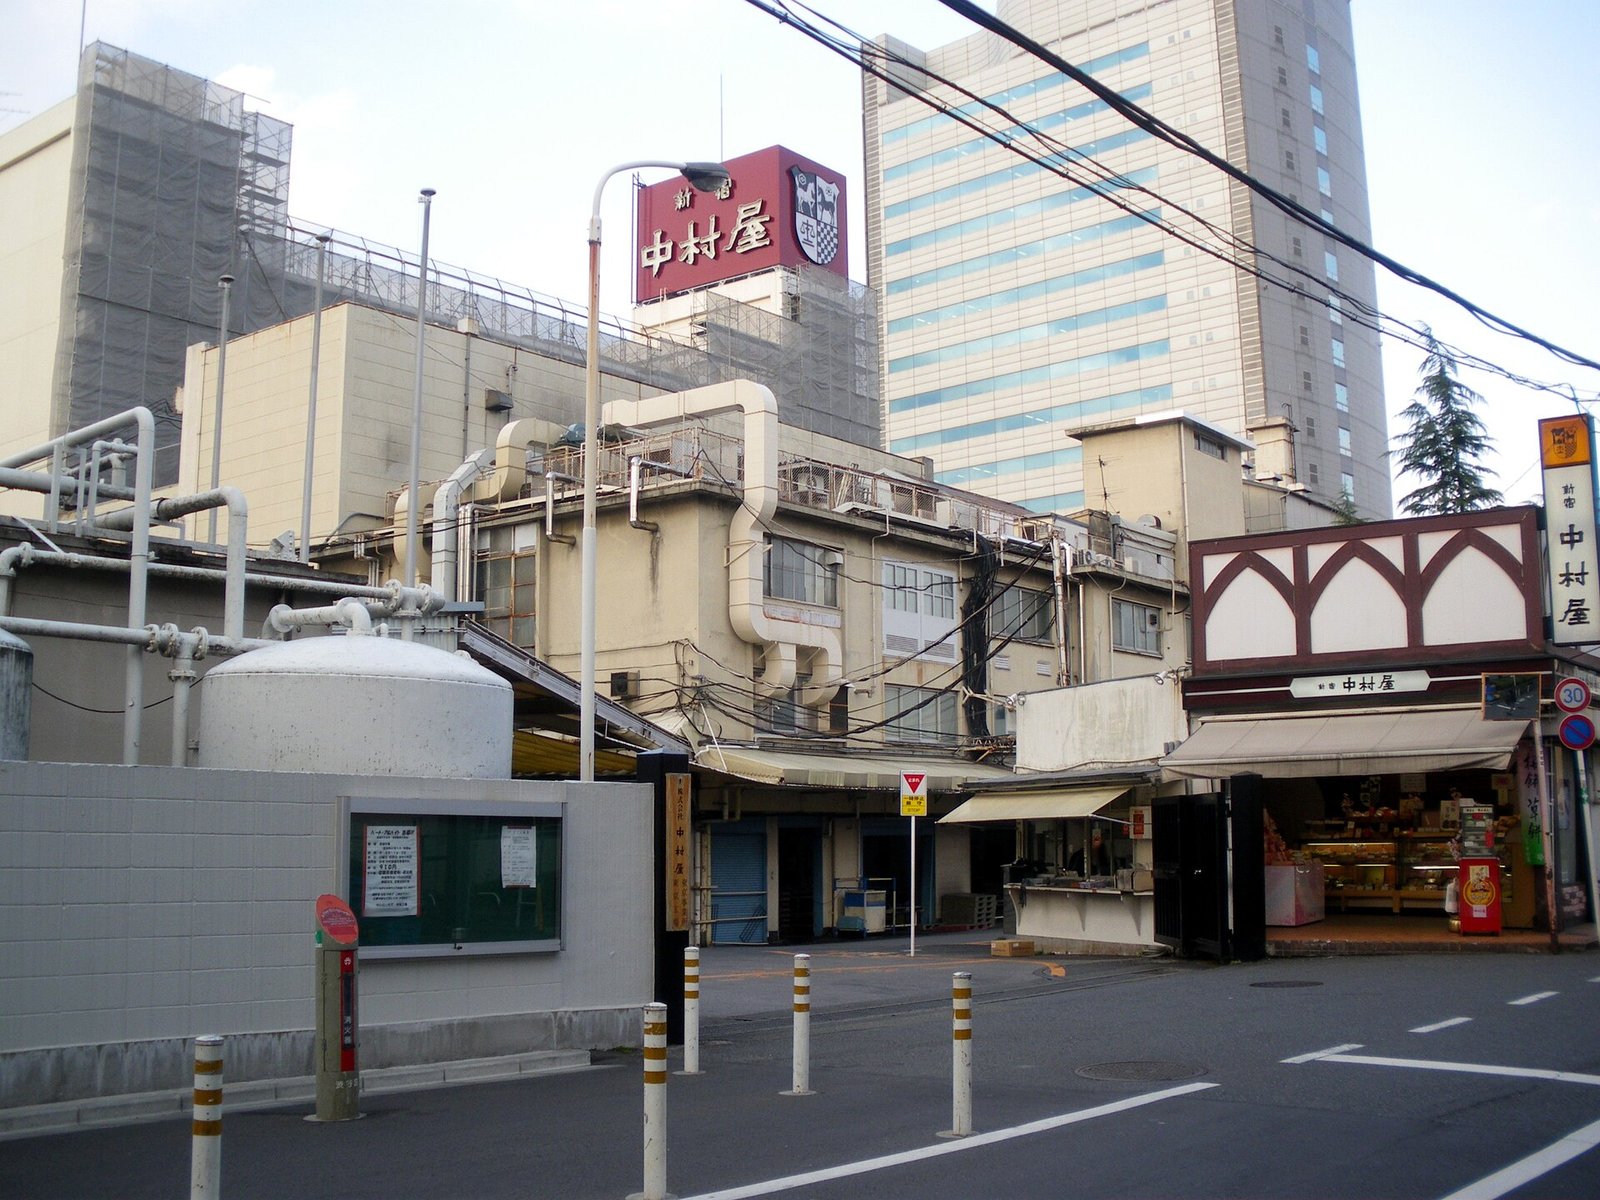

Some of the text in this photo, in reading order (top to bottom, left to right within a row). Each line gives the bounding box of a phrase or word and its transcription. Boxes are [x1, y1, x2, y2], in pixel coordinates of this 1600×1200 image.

[641, 198, 771, 277] 中村屋
[1561, 483, 1576, 509] 新宿
[1558, 523, 1590, 626] 中村屋
[1342, 674, 1395, 692] 中村屋
[1563, 687, 1583, 704] 30
[674, 826, 685, 874] 中村屋
